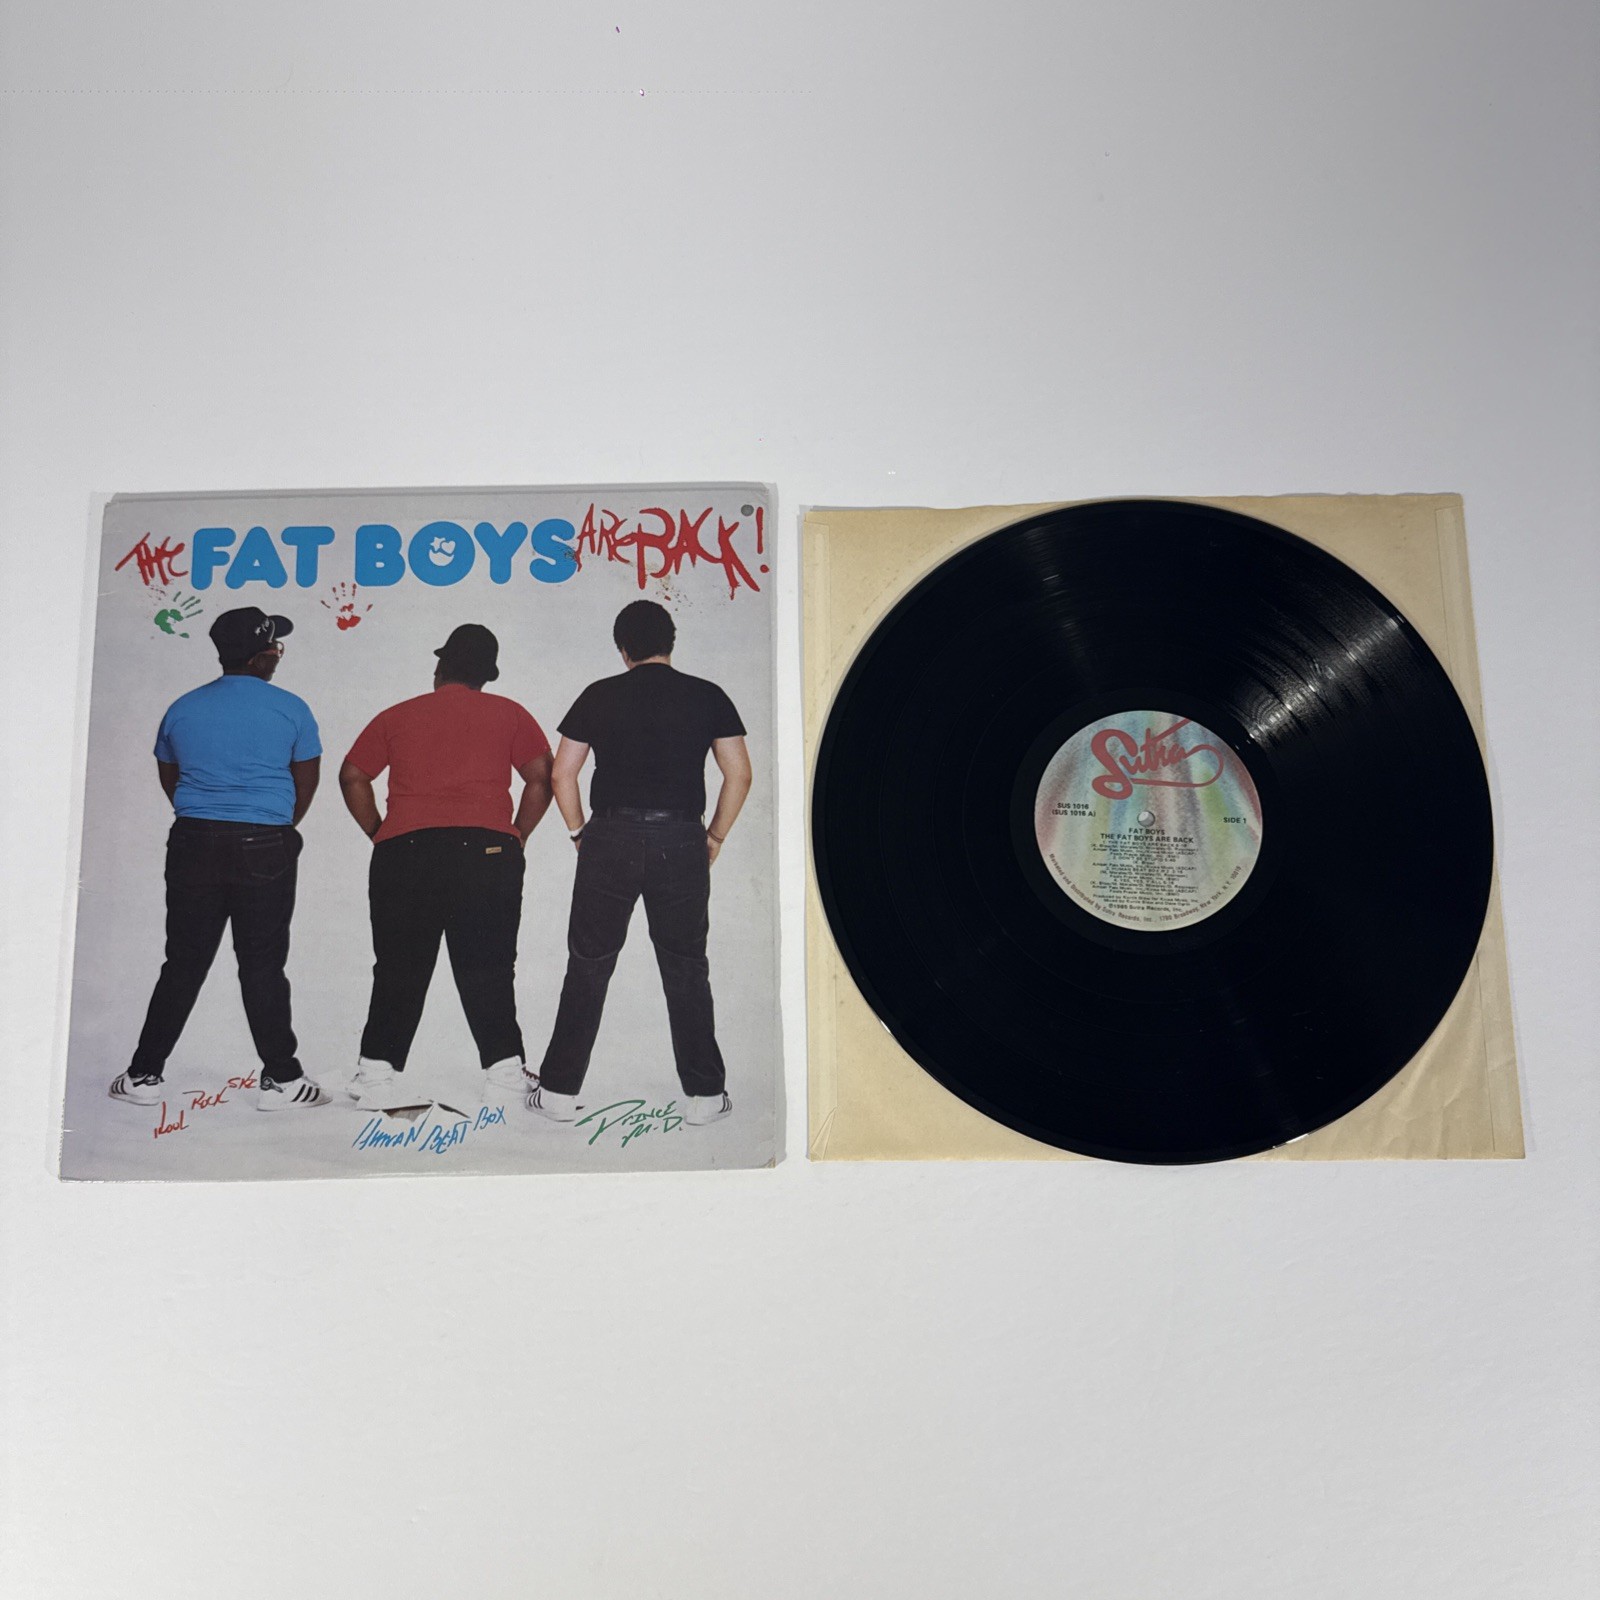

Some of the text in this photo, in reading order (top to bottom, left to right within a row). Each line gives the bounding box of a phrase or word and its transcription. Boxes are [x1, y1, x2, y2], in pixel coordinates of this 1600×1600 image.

[114, 503, 770, 600] THE FAT BOYS ARE BACK!
[1091, 717, 1224, 800] Sutra
[1145, 828, 1165, 836] BOYS
[418, 1117, 473, 1154] BEAT
[473, 1105, 507, 1131] BOX
